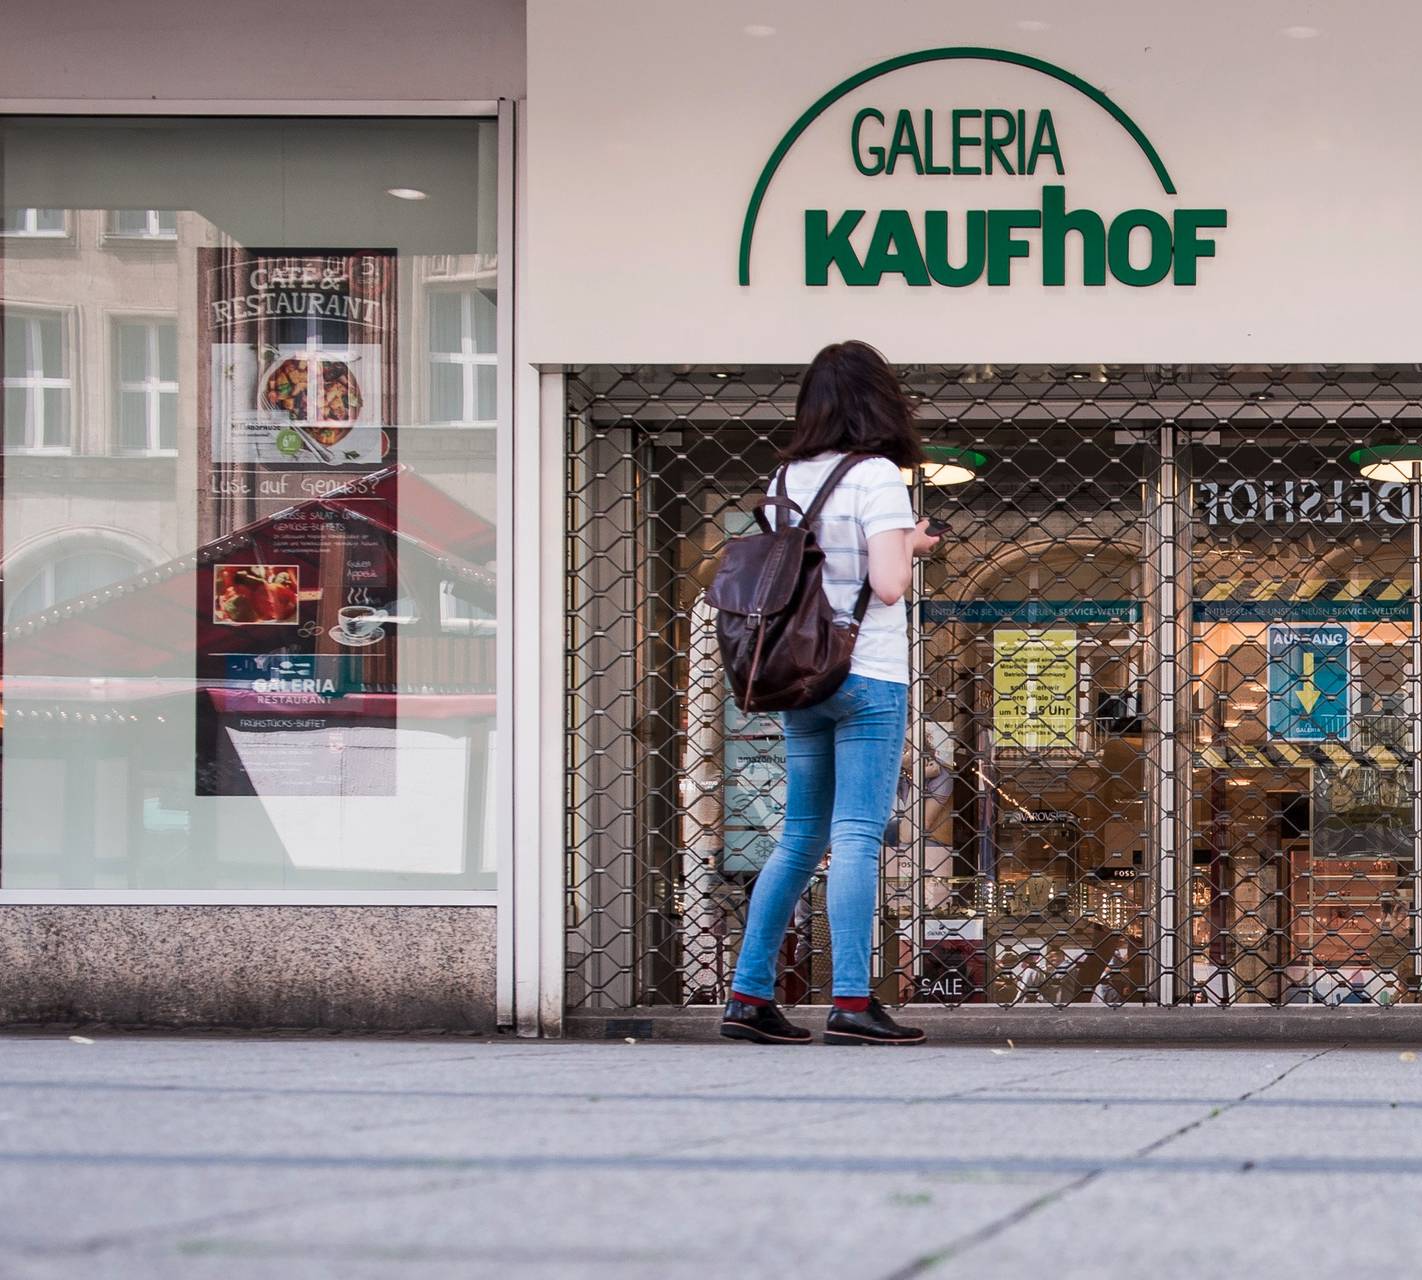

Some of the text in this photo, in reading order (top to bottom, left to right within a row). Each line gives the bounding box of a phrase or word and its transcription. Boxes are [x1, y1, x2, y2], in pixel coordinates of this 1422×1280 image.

[851, 107, 1065, 176] GALERIA
[250, 263, 317, 290] CAFÉ
[211, 292, 381, 323] RESTAURANT
[211, 474, 380, 496] Lust auf Genuss?
[1273, 633, 1344, 645] AUSANG
[252, 678, 335, 693] GALERIA
[257, 695, 332, 704] RESTAURANT
[1014, 705, 1046, 716] 135
[1049, 705, 1072, 716] Uhr
[774, 754, 786, 763] hu
[921, 978, 963, 996] SALE
